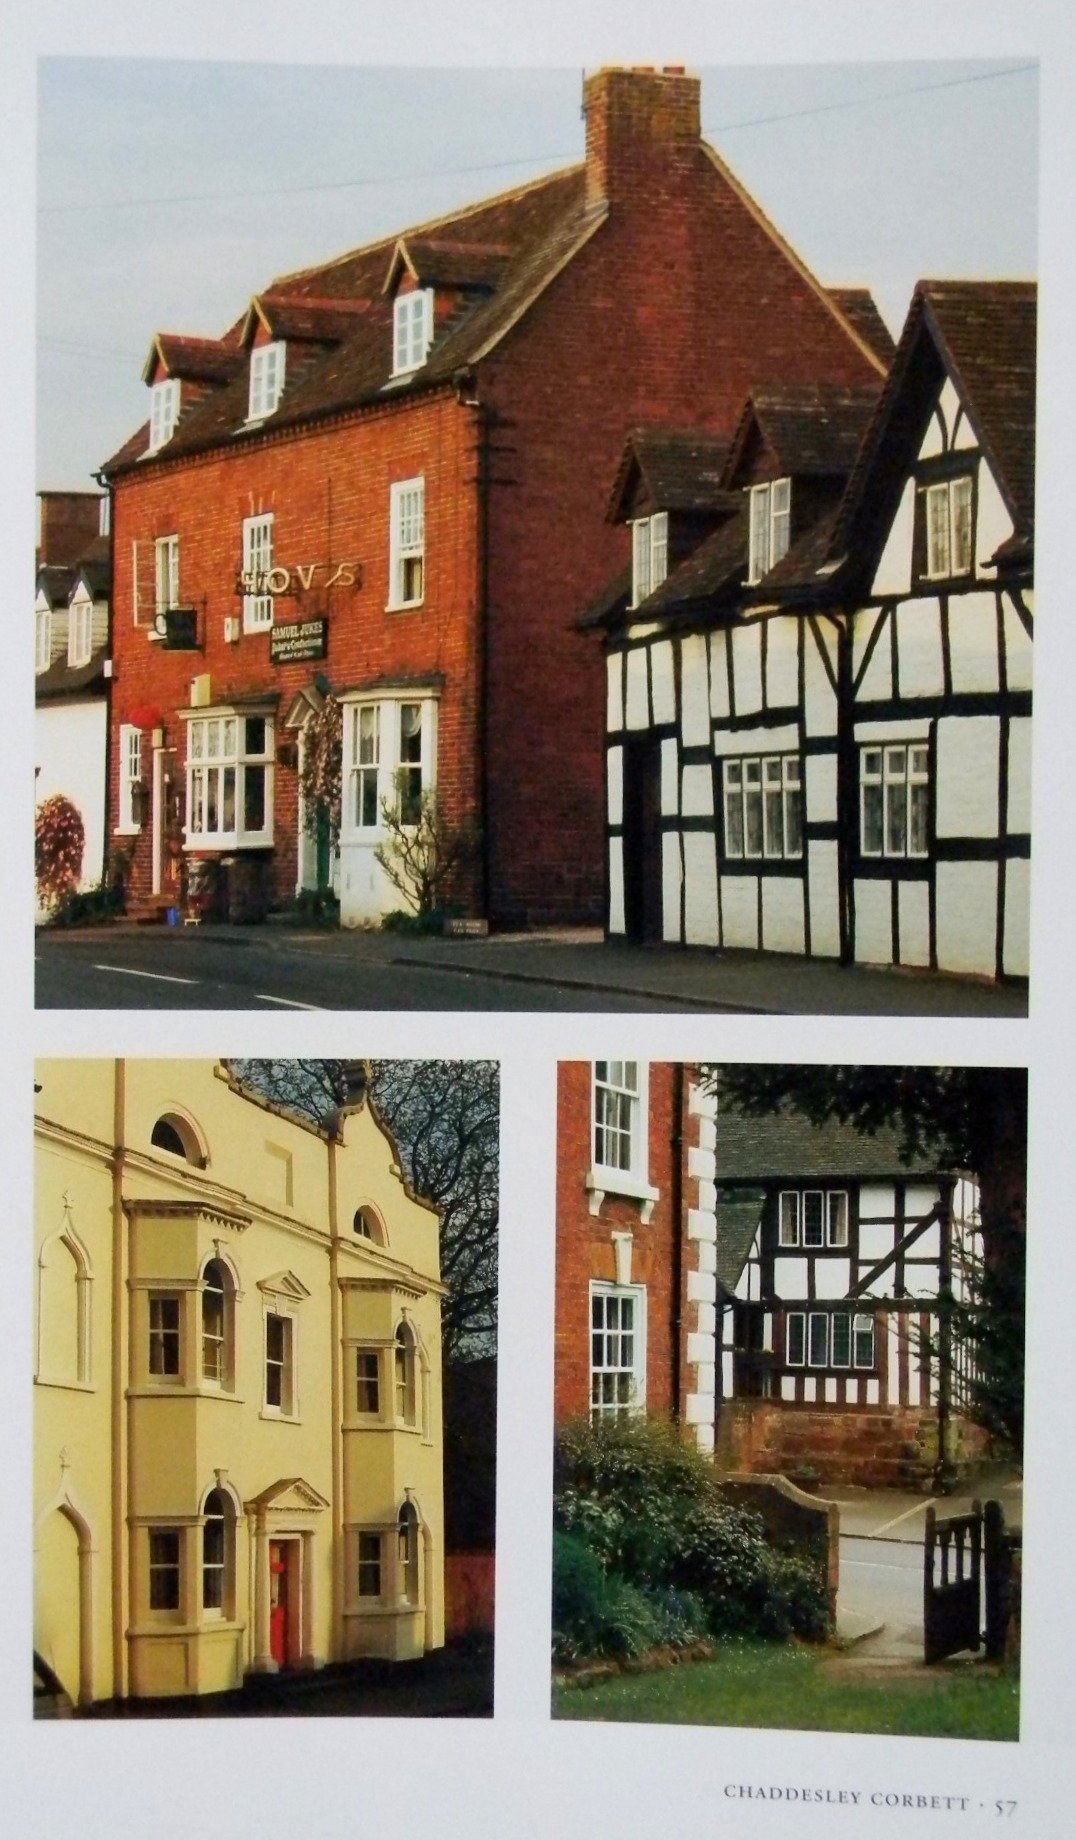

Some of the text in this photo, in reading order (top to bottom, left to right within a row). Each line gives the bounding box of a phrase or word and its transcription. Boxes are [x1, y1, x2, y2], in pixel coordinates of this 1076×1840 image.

[271, 624, 300, 640] SAMUEL
[723, 1784, 1018, 1817] CHADDESLEY CORBETT 57
